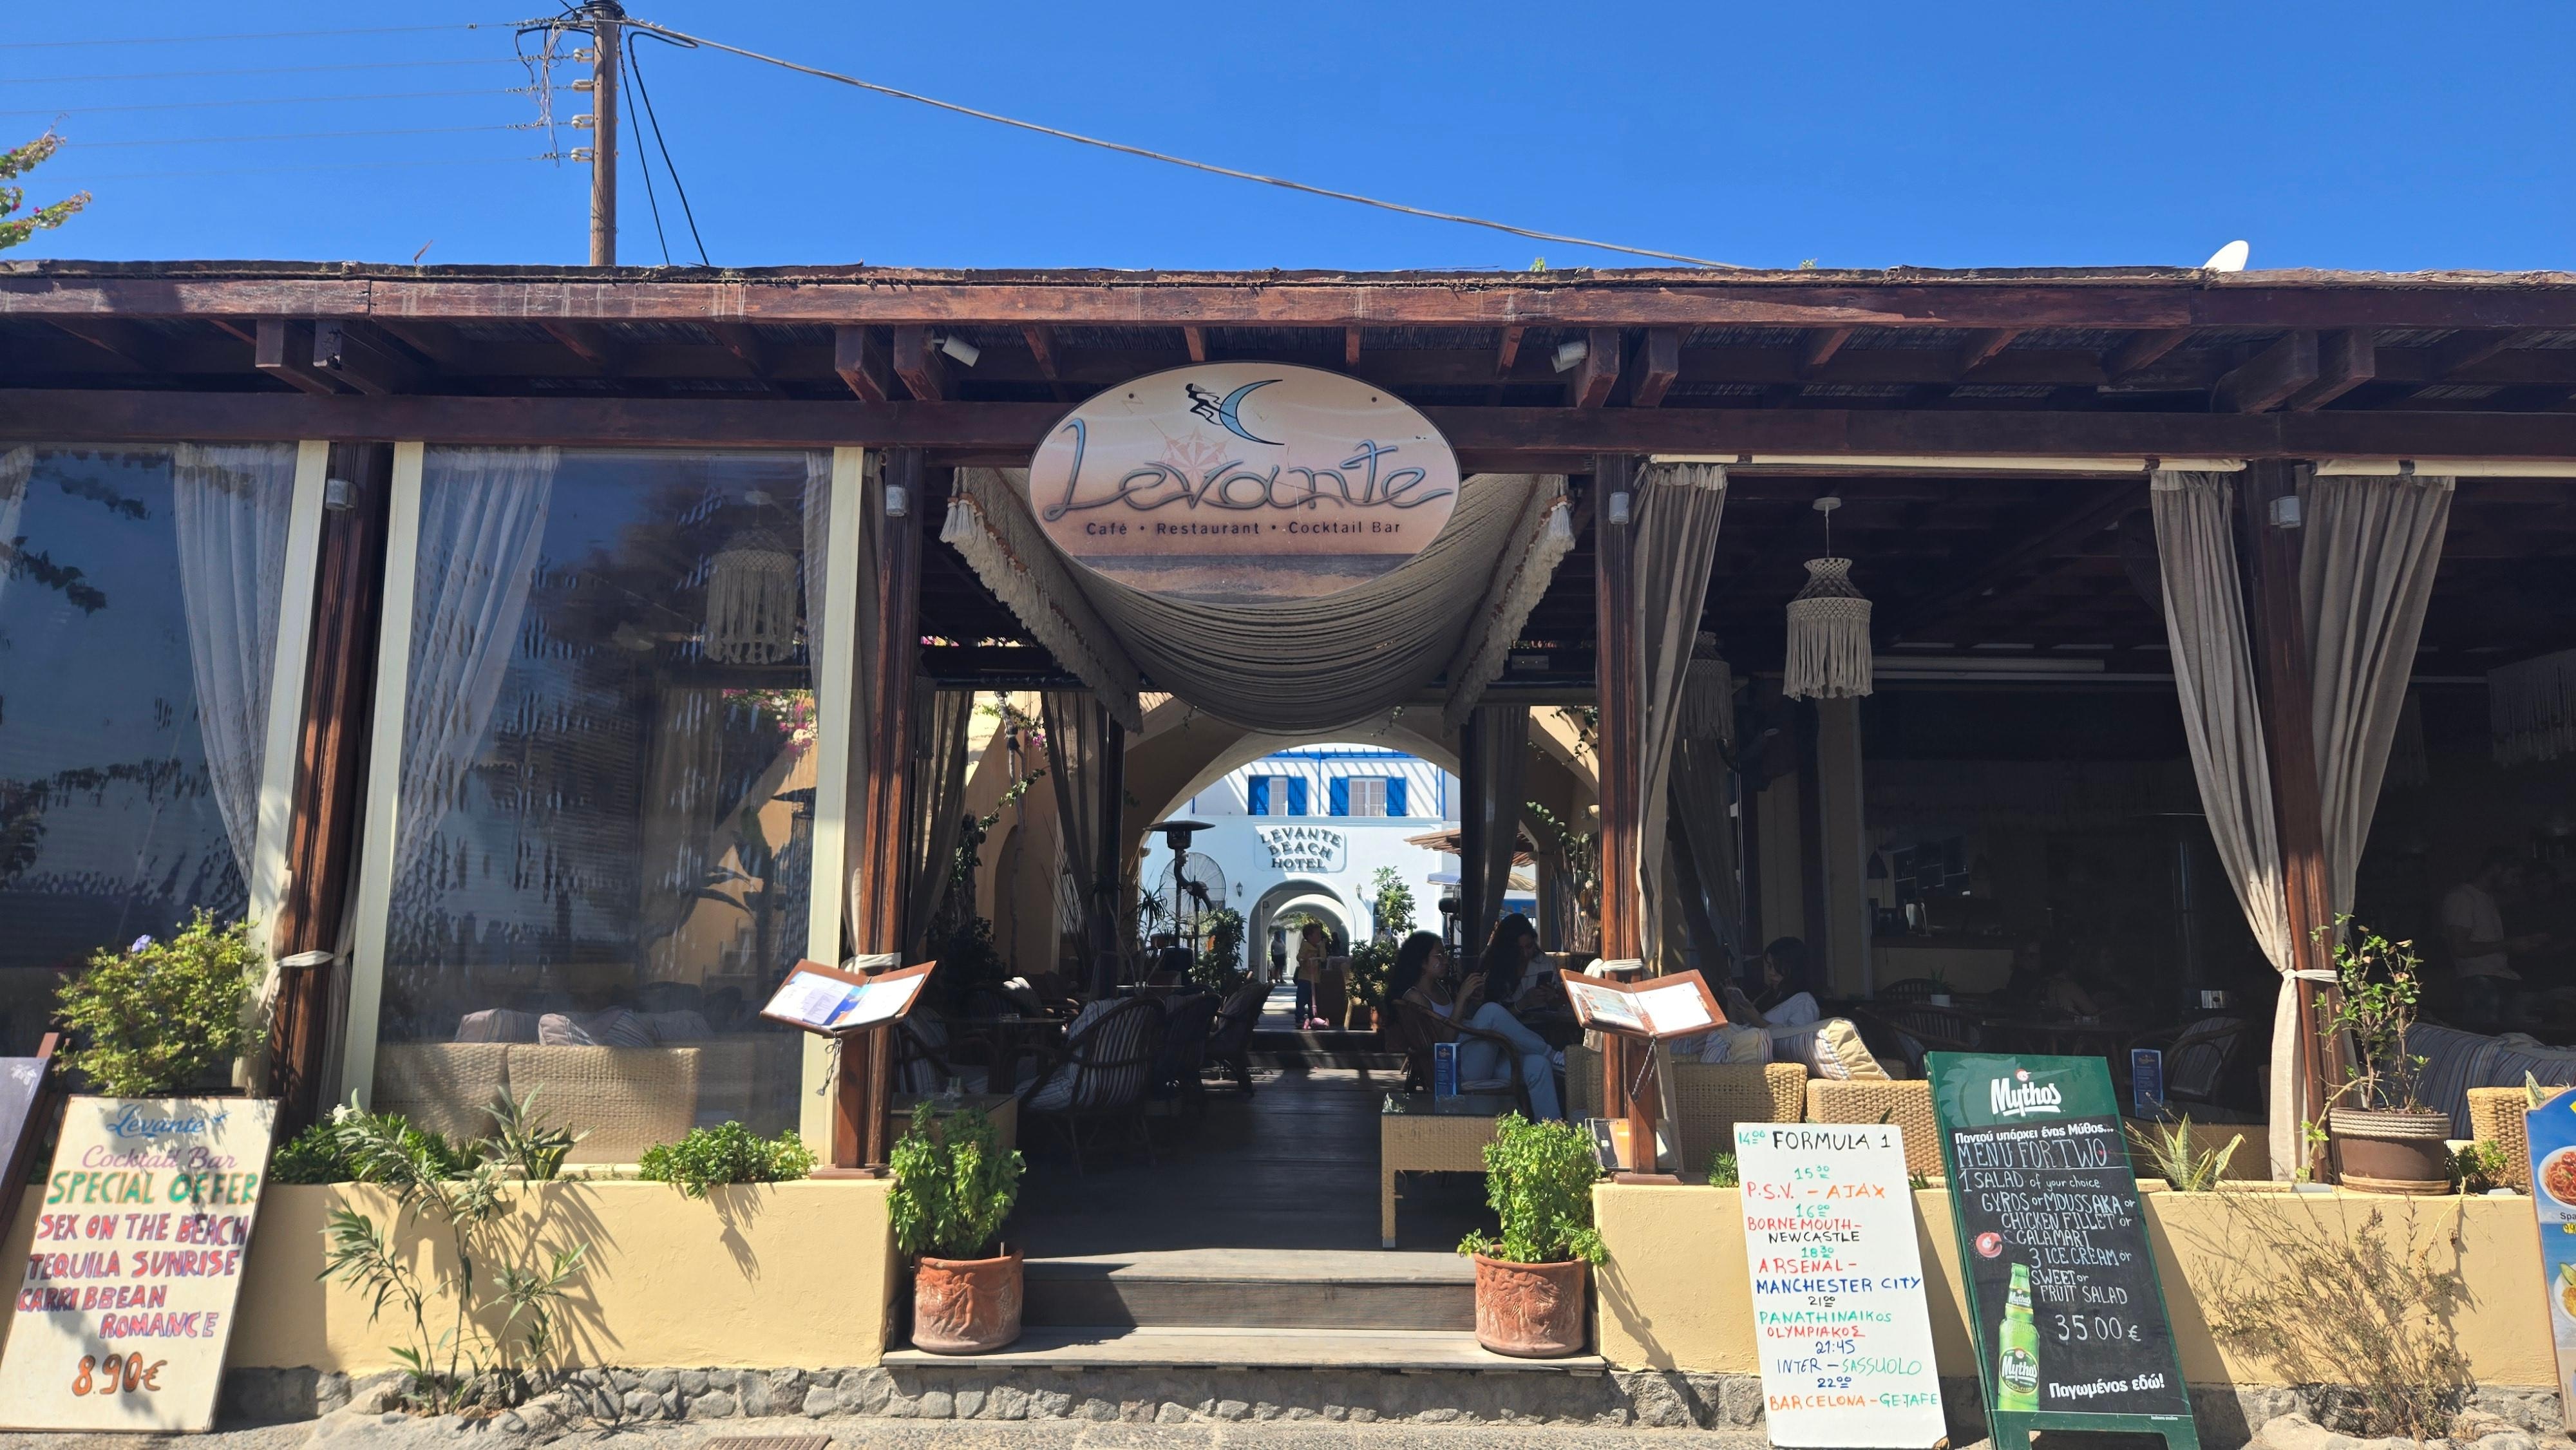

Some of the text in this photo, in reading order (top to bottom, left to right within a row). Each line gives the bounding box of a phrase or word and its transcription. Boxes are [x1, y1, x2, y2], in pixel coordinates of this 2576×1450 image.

[1044, 418, 1452, 522] Levante
[1086, 521, 1401, 535] Café Restaurant Cocktail Bar
[1260, 827, 1343, 847] LEVANTE
[1267, 842, 1333, 860] BEACH
[1271, 858, 1326, 869] HOTEL
[1991, 1078, 2061, 1116] Mythos
[106, 1104, 207, 1138] Levante
[1773, 1131, 1870, 1150] FORMULA
[1880, 1134, 1891, 1148] 1
[1955, 1131, 1993, 1144] Παντού
[1996, 1129, 2038, 1142] υπάρχει
[2041, 1126, 2066, 1138] ένας
[82, 1145, 239, 1169] Cocktail Bar
[1956, 1138, 2107, 1168] MENU FOR TWO
[46, 1170, 258, 1205] SPECIAL OFFER
[1958, 1169, 1972, 1192] 1
[1974, 1171, 2024, 1189] SALAD
[2030, 1173, 2040, 1189] of
[2046, 1178, 2067, 1191] your
[1747, 1182, 1794, 1200] P.S.V.
[1826, 1183, 1885, 1199] AJAX
[1982, 1191, 2136, 1215] GYROS or MOUSSAKA or
[37, 1213, 249, 1246] SEX ON THE BEACH
[2001, 1212, 2132, 1230] CHICKEN FILLET or
[1768, 1231, 1860, 1244] NEWCASTLE
[2016, 1230, 2090, 1249] CALAMARI
[29, 1250, 240, 1280] TEQUILA SUNRISE
[2029, 1247, 2132, 1269] 3 ICE CREAM or
[1756, 1276, 1920, 1294] MANCHESTER CITY
[2031, 1269, 2089, 1285] SWEET or
[2040, 1285, 2128, 1304] FRUIT SALAD
[99, 1312, 220, 1339] ROMANCE
[1815, 1339, 1855, 1354] 21:45
[1777, 1358, 1822, 1374] INTER
[1842, 1357, 1922, 1376] SASSUOLO
[2002, 1355, 2038, 1381] Mythos
[2049, 1378, 2128, 1399] Παγωμένος
[2132, 1373, 2164, 1391] εδώ!
[1769, 1395, 1866, 1411] BARCELONA
